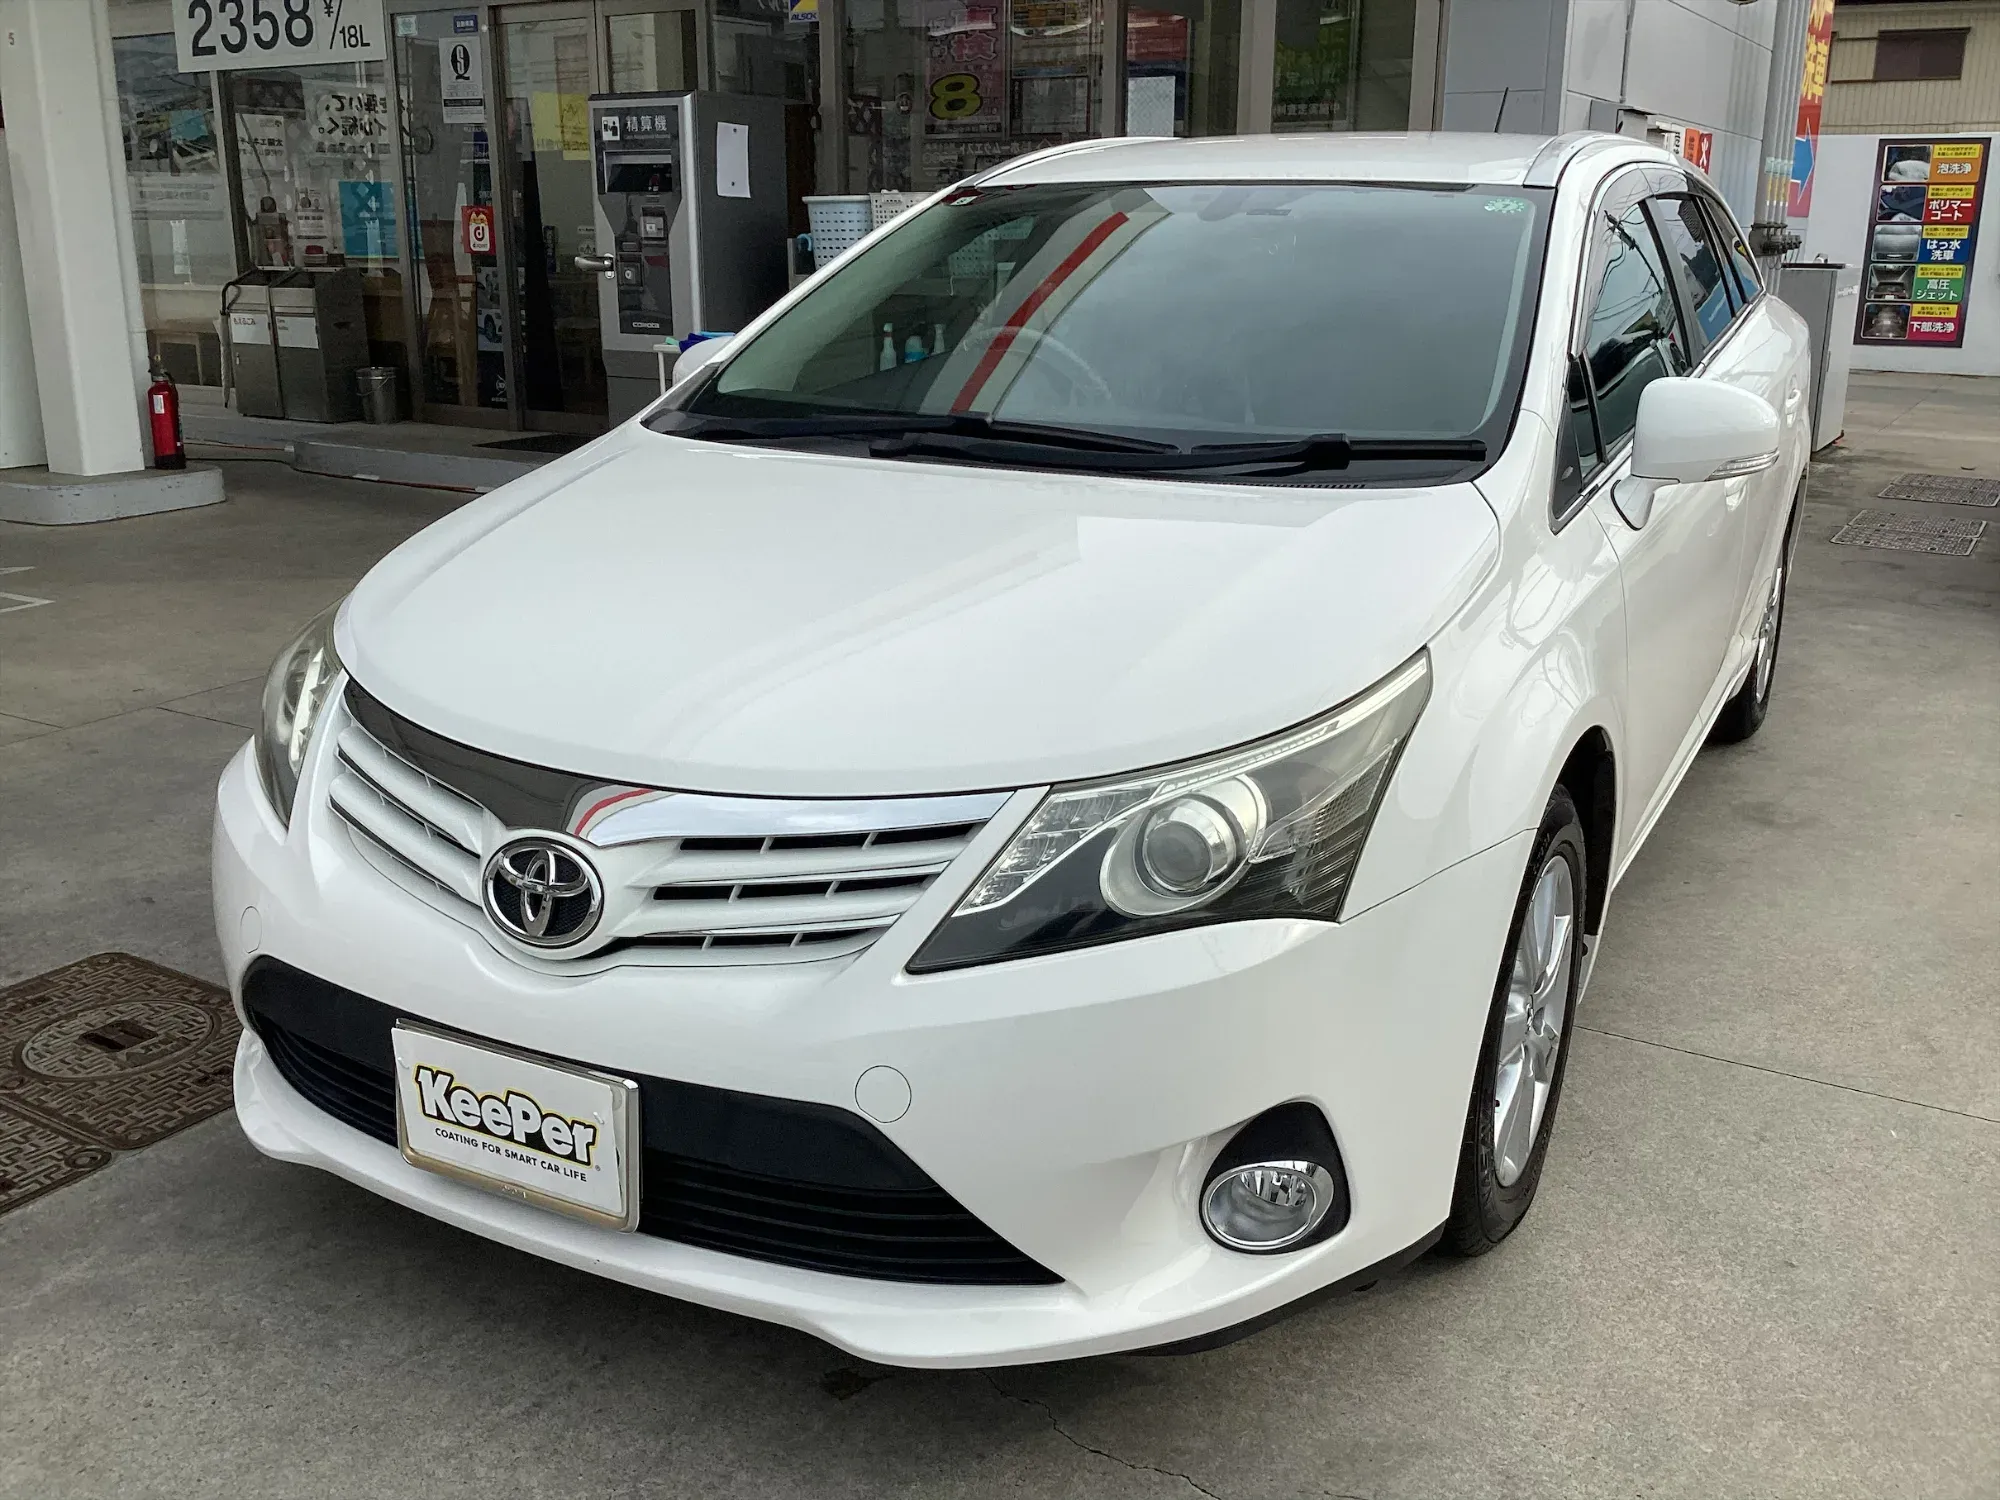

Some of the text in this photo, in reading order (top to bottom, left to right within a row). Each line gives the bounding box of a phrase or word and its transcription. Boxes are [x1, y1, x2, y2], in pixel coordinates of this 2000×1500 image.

[791, 13, 817, 21] ALSOK
[188, 0, 314, 57] 2358
[8, 32, 15, 46] 5
[625, 114, 667, 132] 精算機
[1936, 162, 1972, 175] 泡洗浄
[1928, 200, 1972, 210] ポリマー
[1930, 210, 1963, 221] コート
[1926, 239, 1961, 250] はっ水
[1930, 249, 1955, 261] 洗車
[1927, 279, 1951, 290] 高圧
[1916, 289, 1958, 300] ジェット
[1910, 321, 1955, 334] 下部洗浄
[415, 1064, 598, 1168] KeePer
[435, 1127, 588, 1182] COATING FOR SMART CAR LIFE
